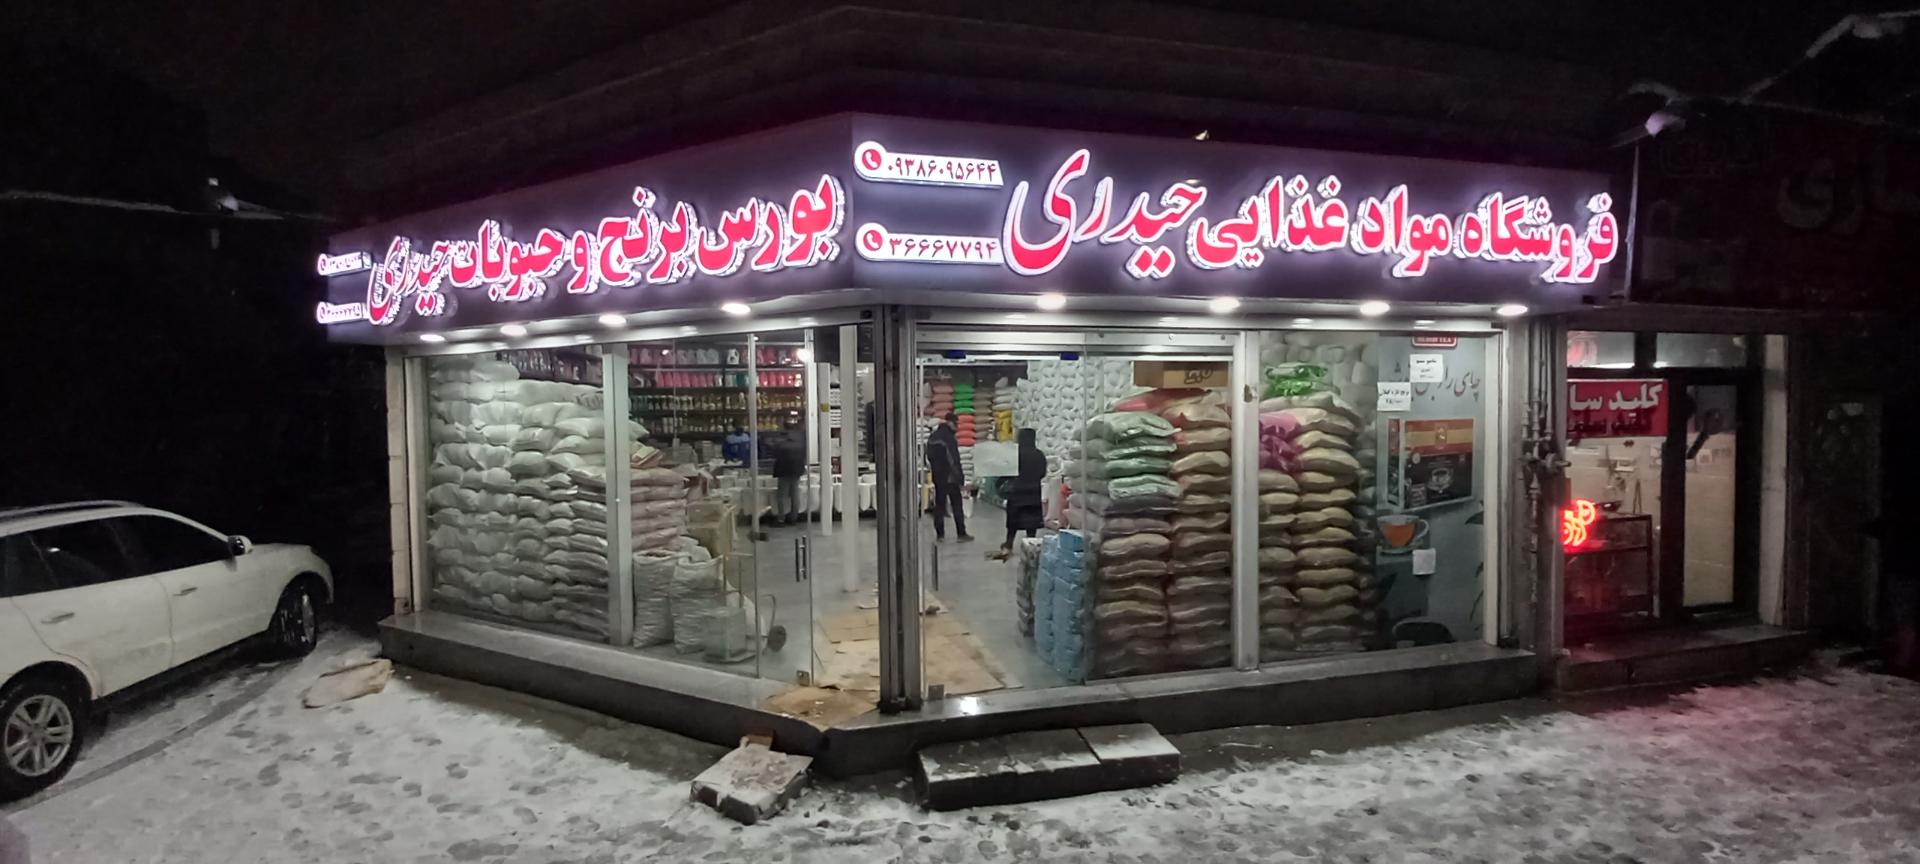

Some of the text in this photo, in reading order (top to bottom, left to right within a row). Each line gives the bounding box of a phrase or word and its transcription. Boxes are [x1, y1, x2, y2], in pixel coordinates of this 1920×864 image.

[888, 157, 997, 182] ۰۹۳۸۶۰۹۵۶۴۴
[1003, 148, 1618, 284] فروشگاه مواد غذایی حیدری
[367, 174, 844, 326] بورس برنج و حبوبات حیدری
[889, 238, 998, 260] ۳۶۶۶۷۷۹۴
[1569, 383, 1663, 417] کلید سا
